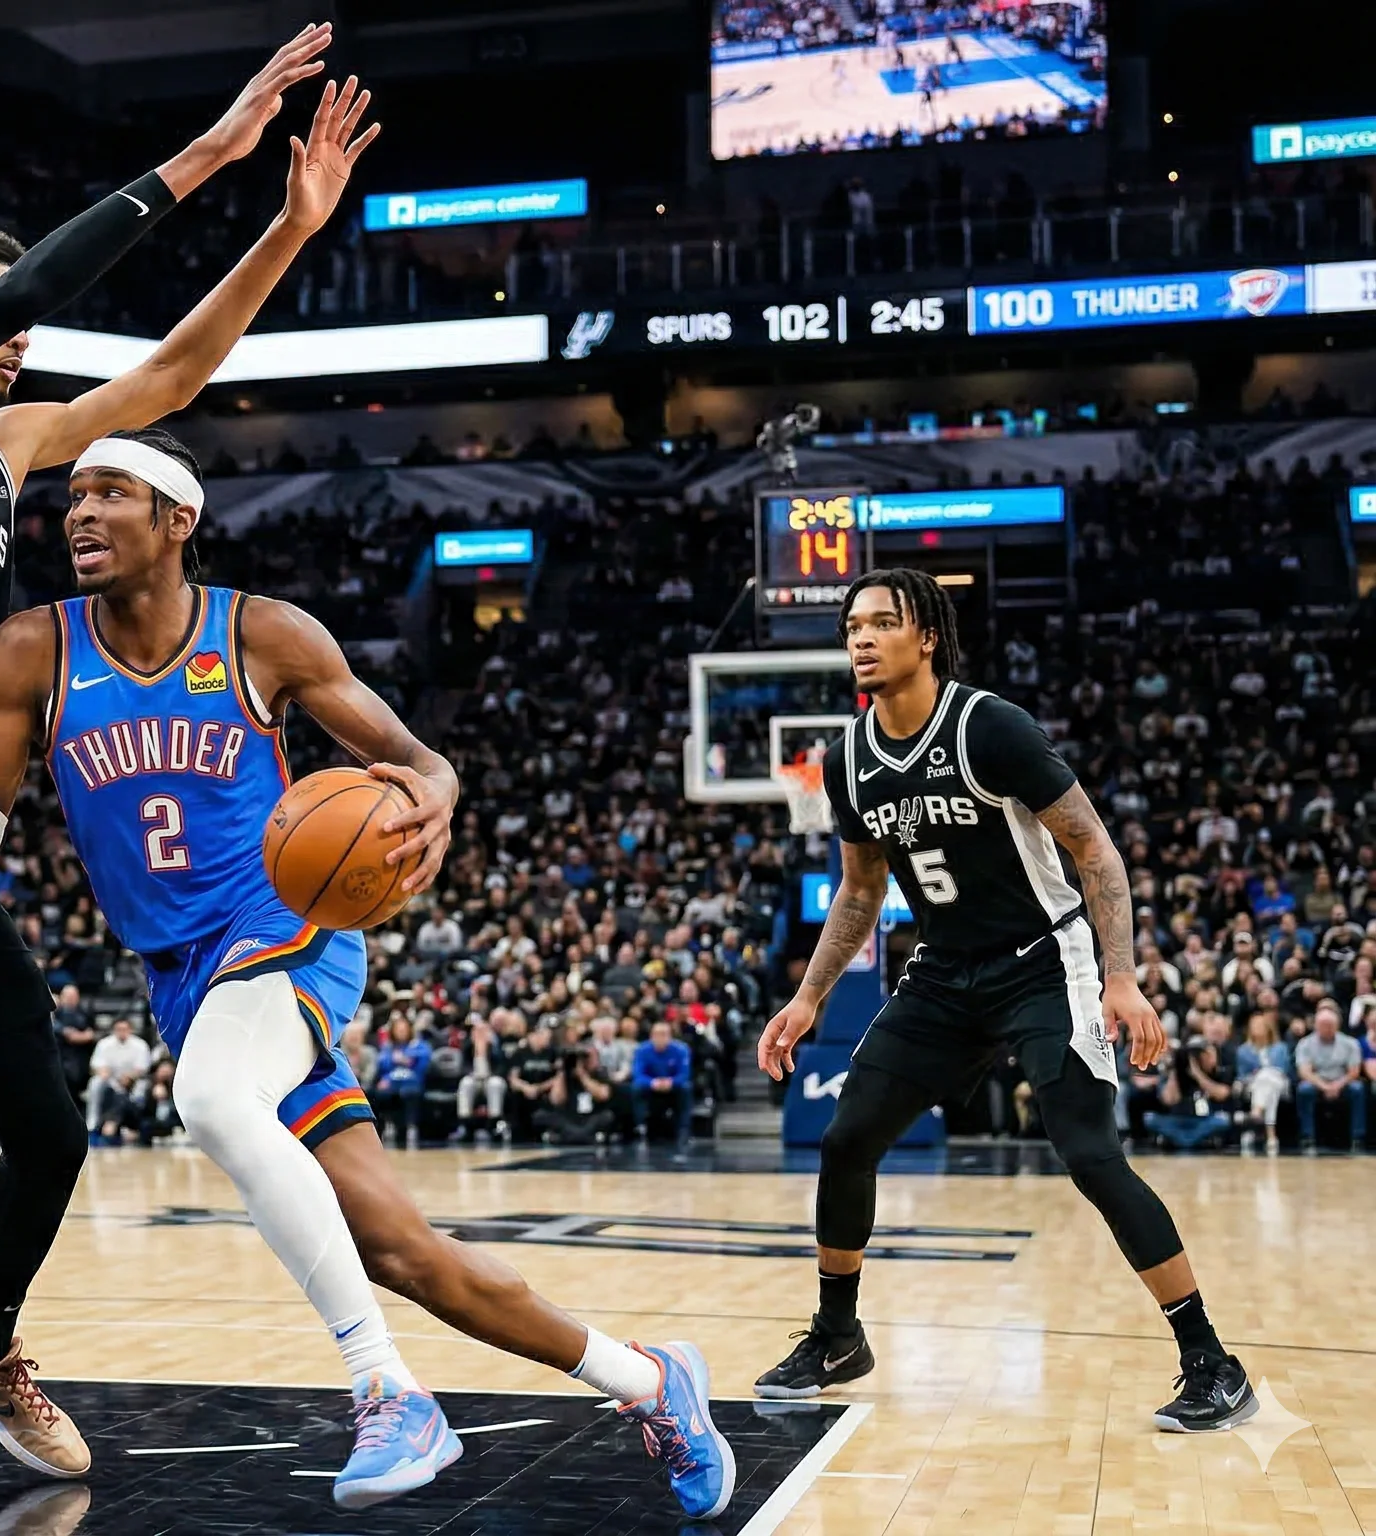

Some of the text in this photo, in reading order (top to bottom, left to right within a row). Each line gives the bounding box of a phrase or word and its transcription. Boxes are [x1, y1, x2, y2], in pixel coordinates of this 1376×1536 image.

[1305, 131, 1376, 156] payco
[646, 303, 830, 344] SPURS 102
[870, 297, 945, 334] 2:45
[983, 289, 1053, 327] 100
[1072, 282, 1199, 318] THUNDER
[788, 496, 855, 531] 2:45
[800, 531, 848, 577] 14
[62, 716, 246, 791] THUNDER
[140, 794, 191, 873] 2
[862, 795, 979, 848] SPURS
[909, 849, 958, 905] 5
